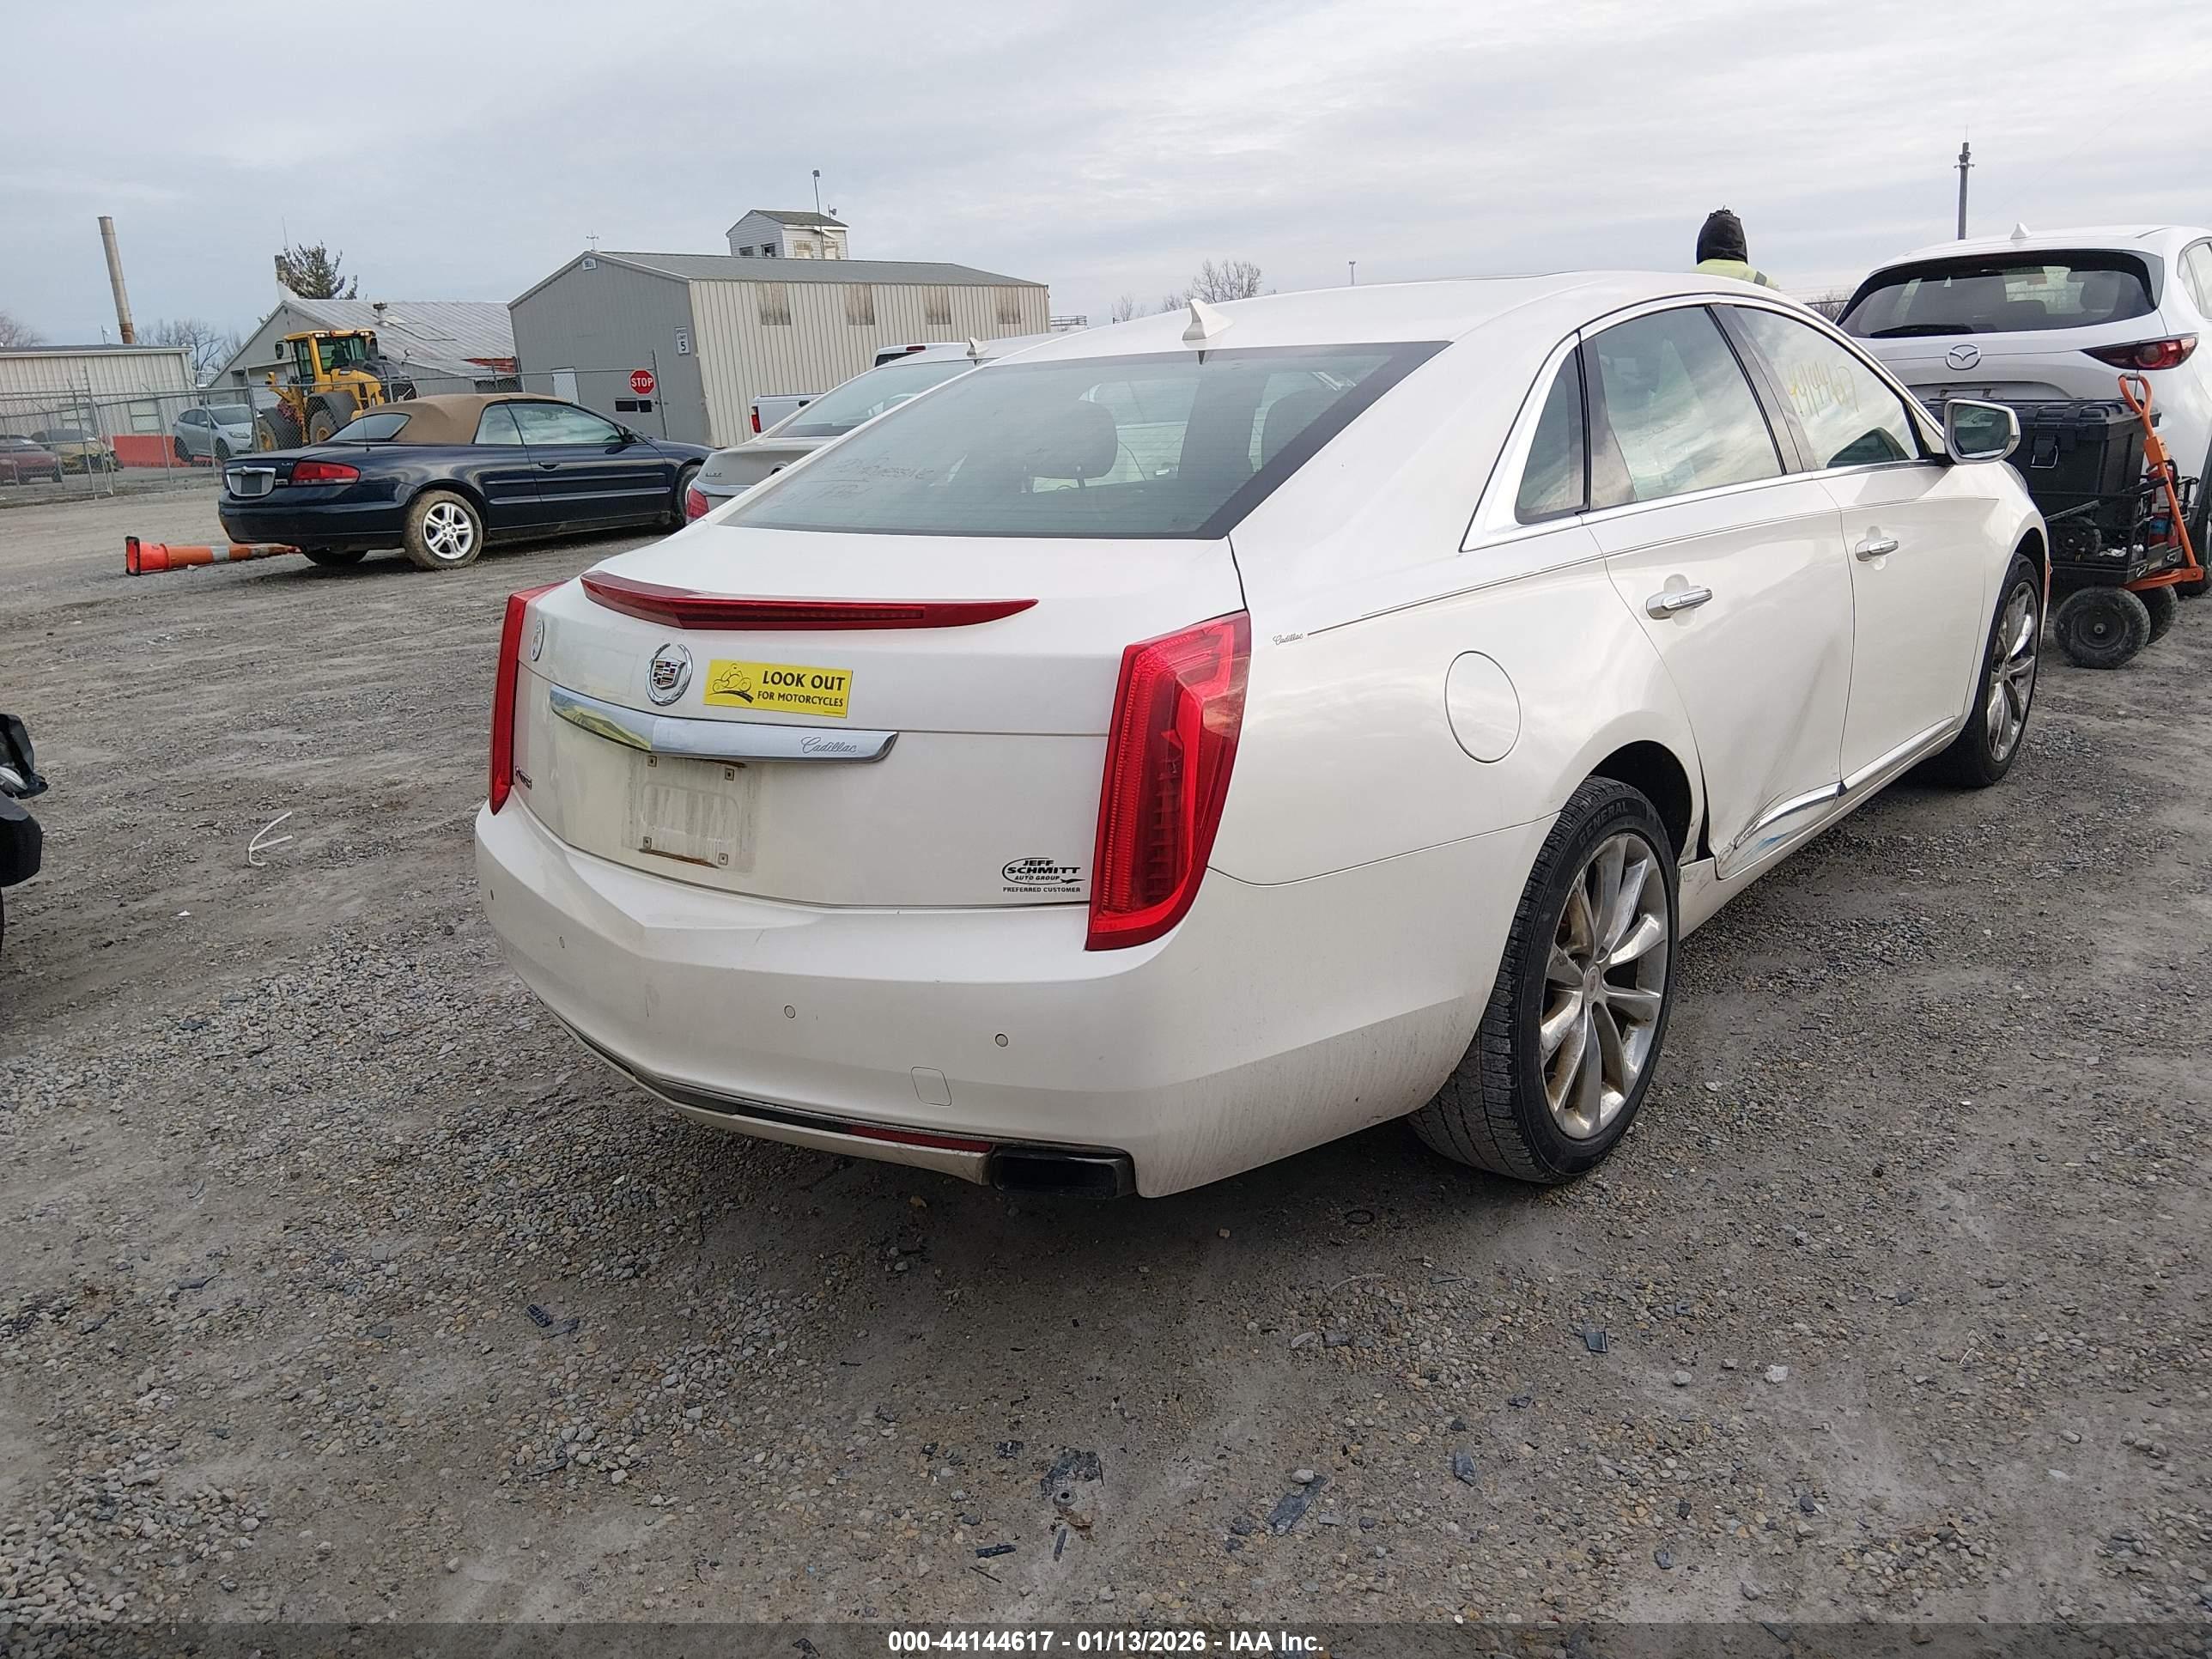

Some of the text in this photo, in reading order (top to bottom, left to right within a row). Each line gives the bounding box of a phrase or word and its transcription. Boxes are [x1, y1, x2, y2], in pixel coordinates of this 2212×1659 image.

[680, 341, 687, 351] 5
[631, 377, 653, 387] STOP
[1272, 633, 1304, 645] Cadillac
[763, 671, 846, 691] LOOK OUT
[757, 690, 843, 708] FOR MOTORCYCLES
[800, 736, 857, 754] Cadillac
[1578, 800, 1629, 848] GENERAL
